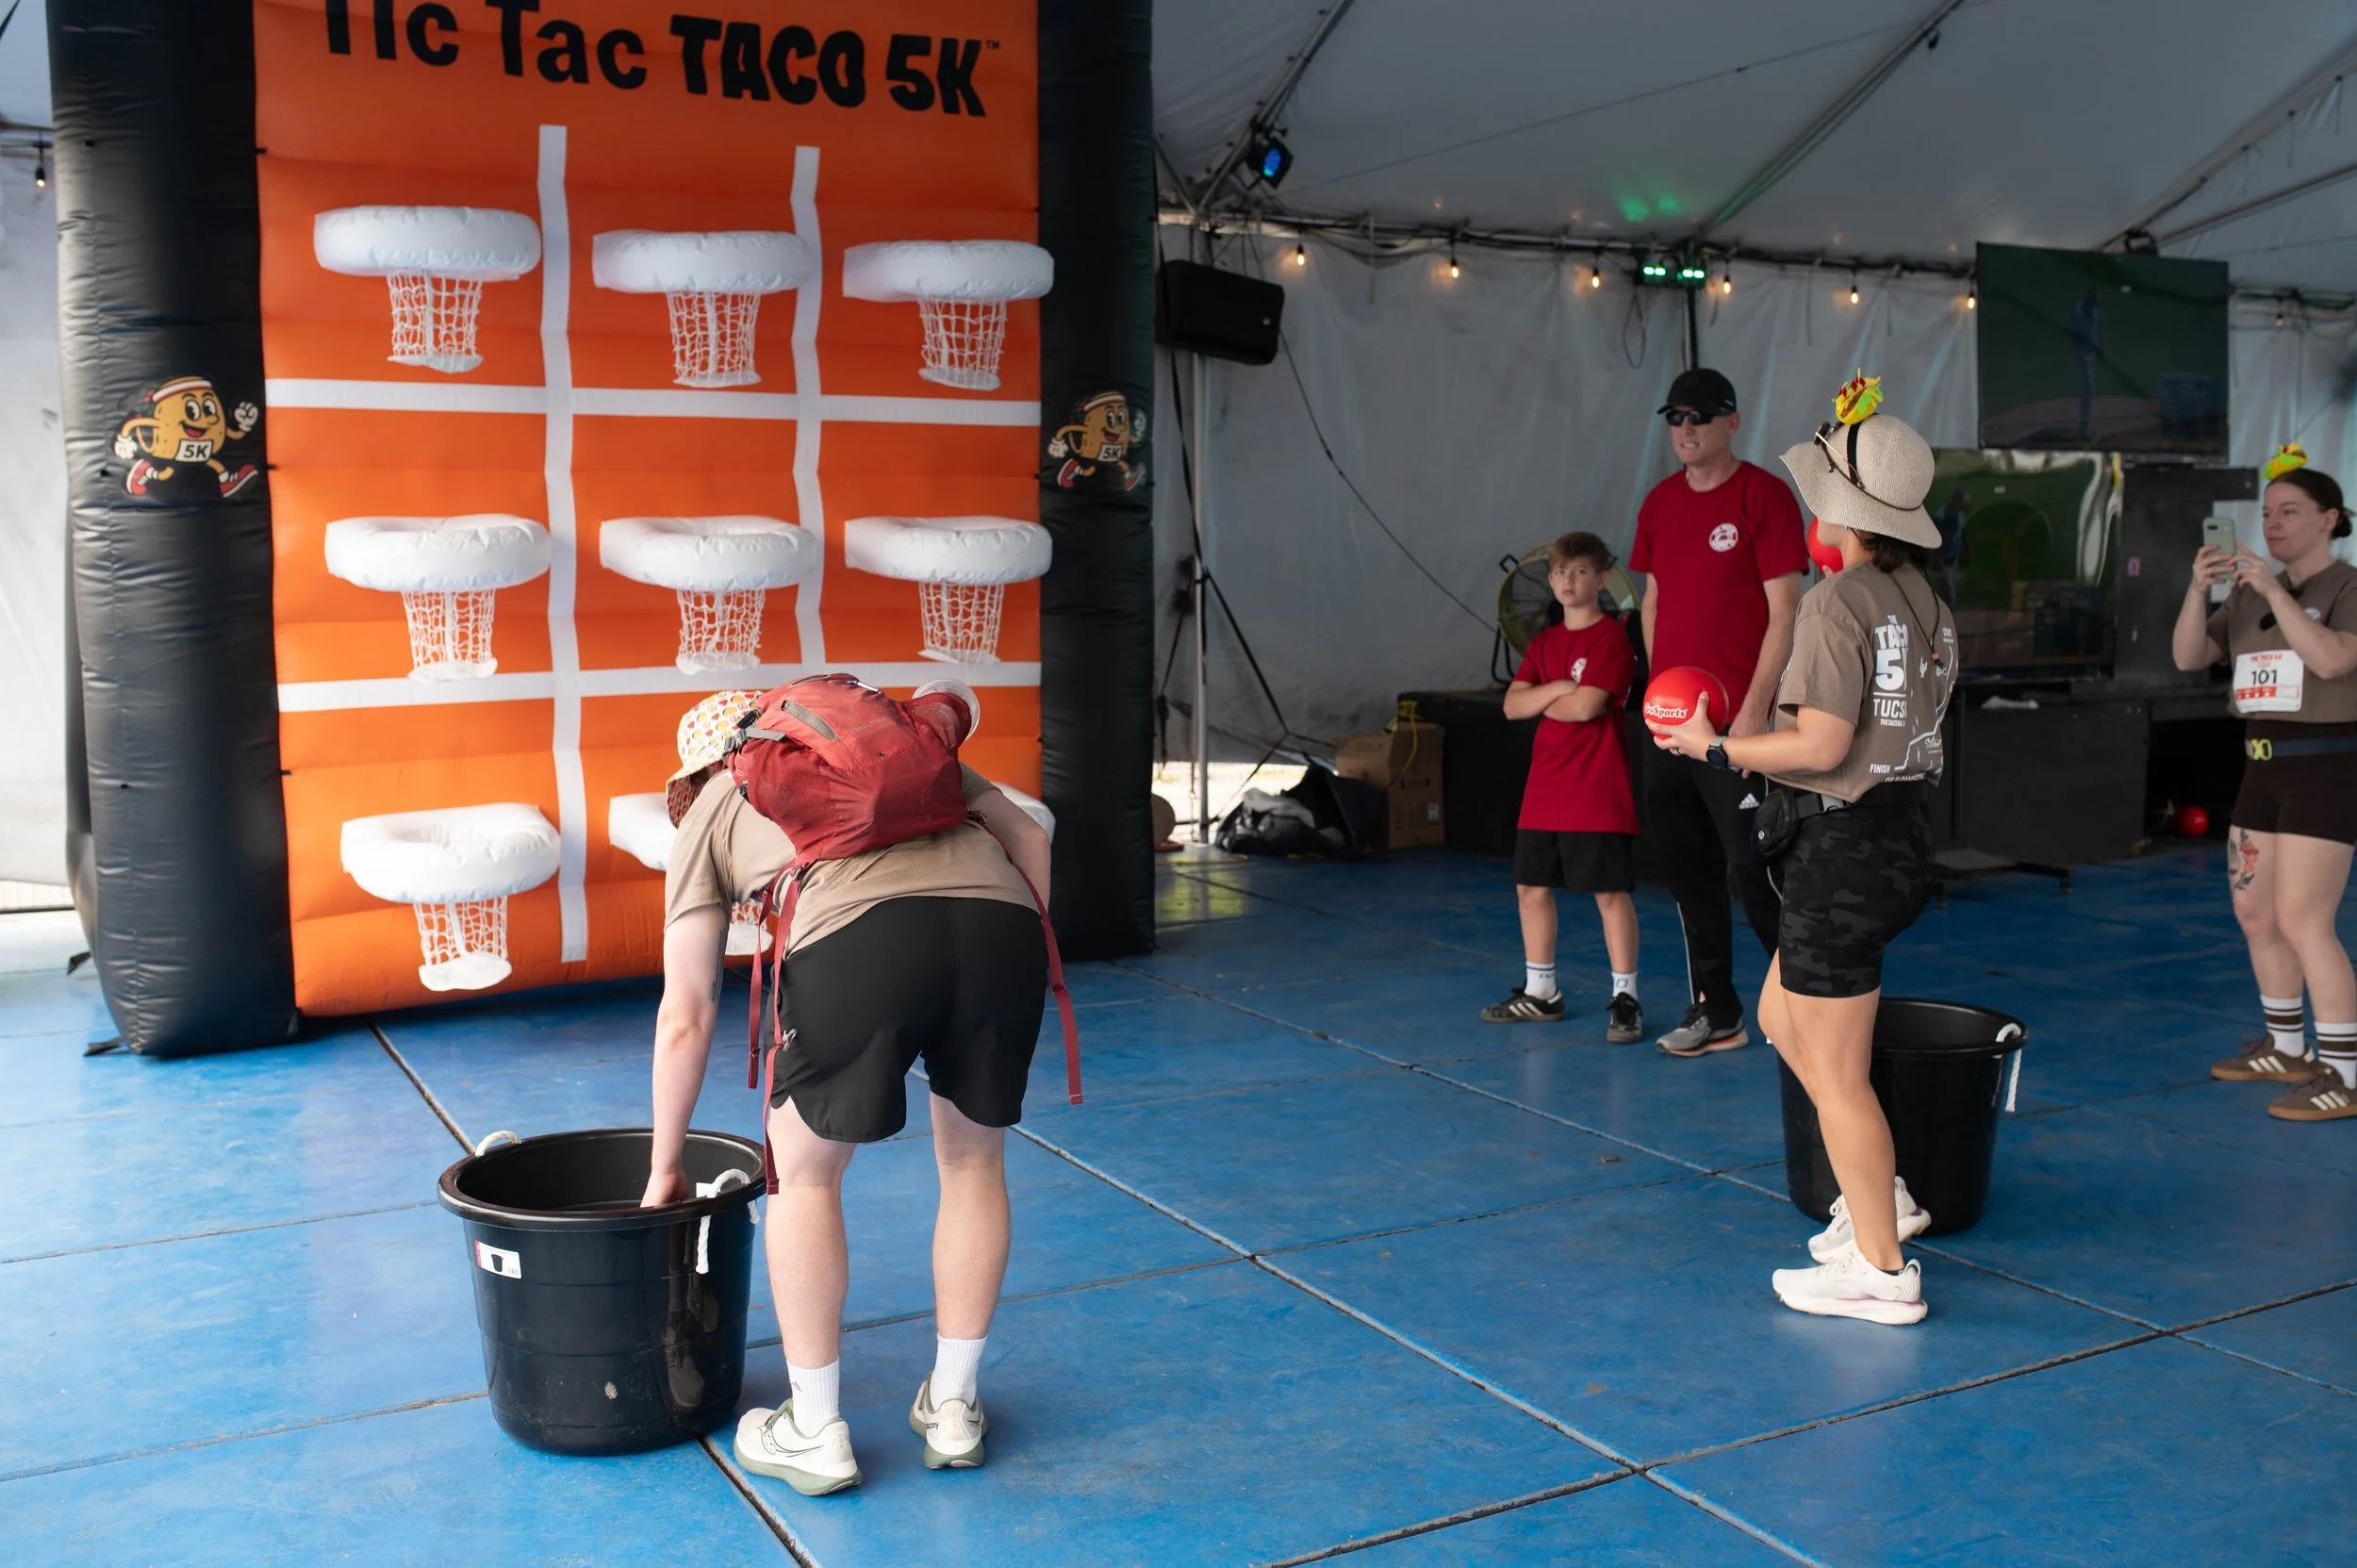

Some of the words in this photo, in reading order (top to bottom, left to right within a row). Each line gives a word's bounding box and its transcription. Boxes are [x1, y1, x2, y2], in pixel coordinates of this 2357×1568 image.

[485, 0, 647, 91] Tac
[669, 14, 866, 108] TACO
[183, 444, 208, 458] 5K
[1103, 448, 1120, 459] 5K
[2250, 668, 2278, 685] 101
[1645, 702, 1688, 718] GoSports
[1870, 764, 1890, 774] FINISH
